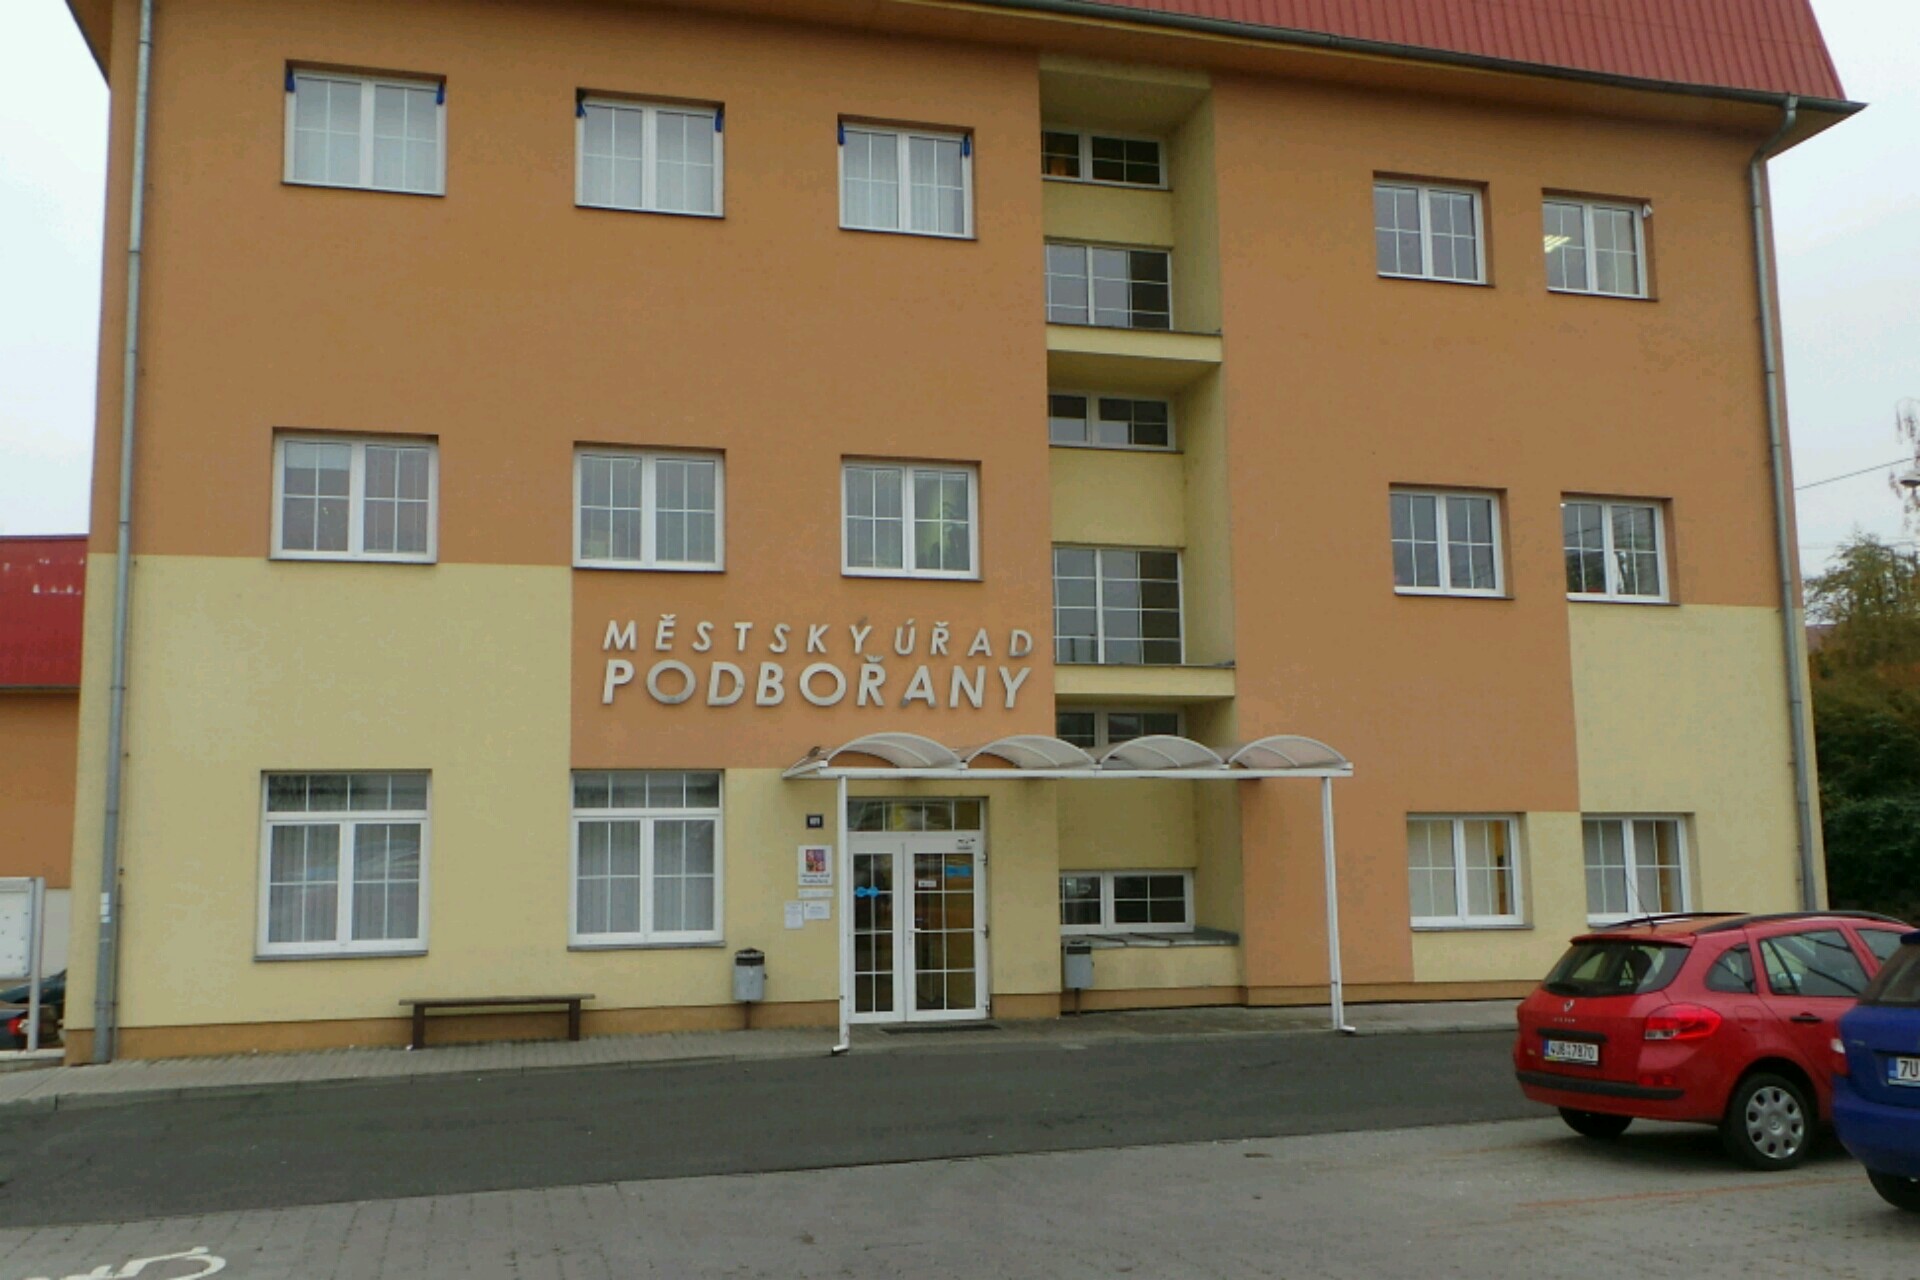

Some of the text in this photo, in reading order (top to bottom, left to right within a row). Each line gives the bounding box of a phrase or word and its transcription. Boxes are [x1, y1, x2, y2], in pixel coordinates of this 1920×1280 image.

[603, 614, 1033, 656] MĚSTSKÝ ÚŘAD
[602, 655, 1031, 708] PODBOŘANY
